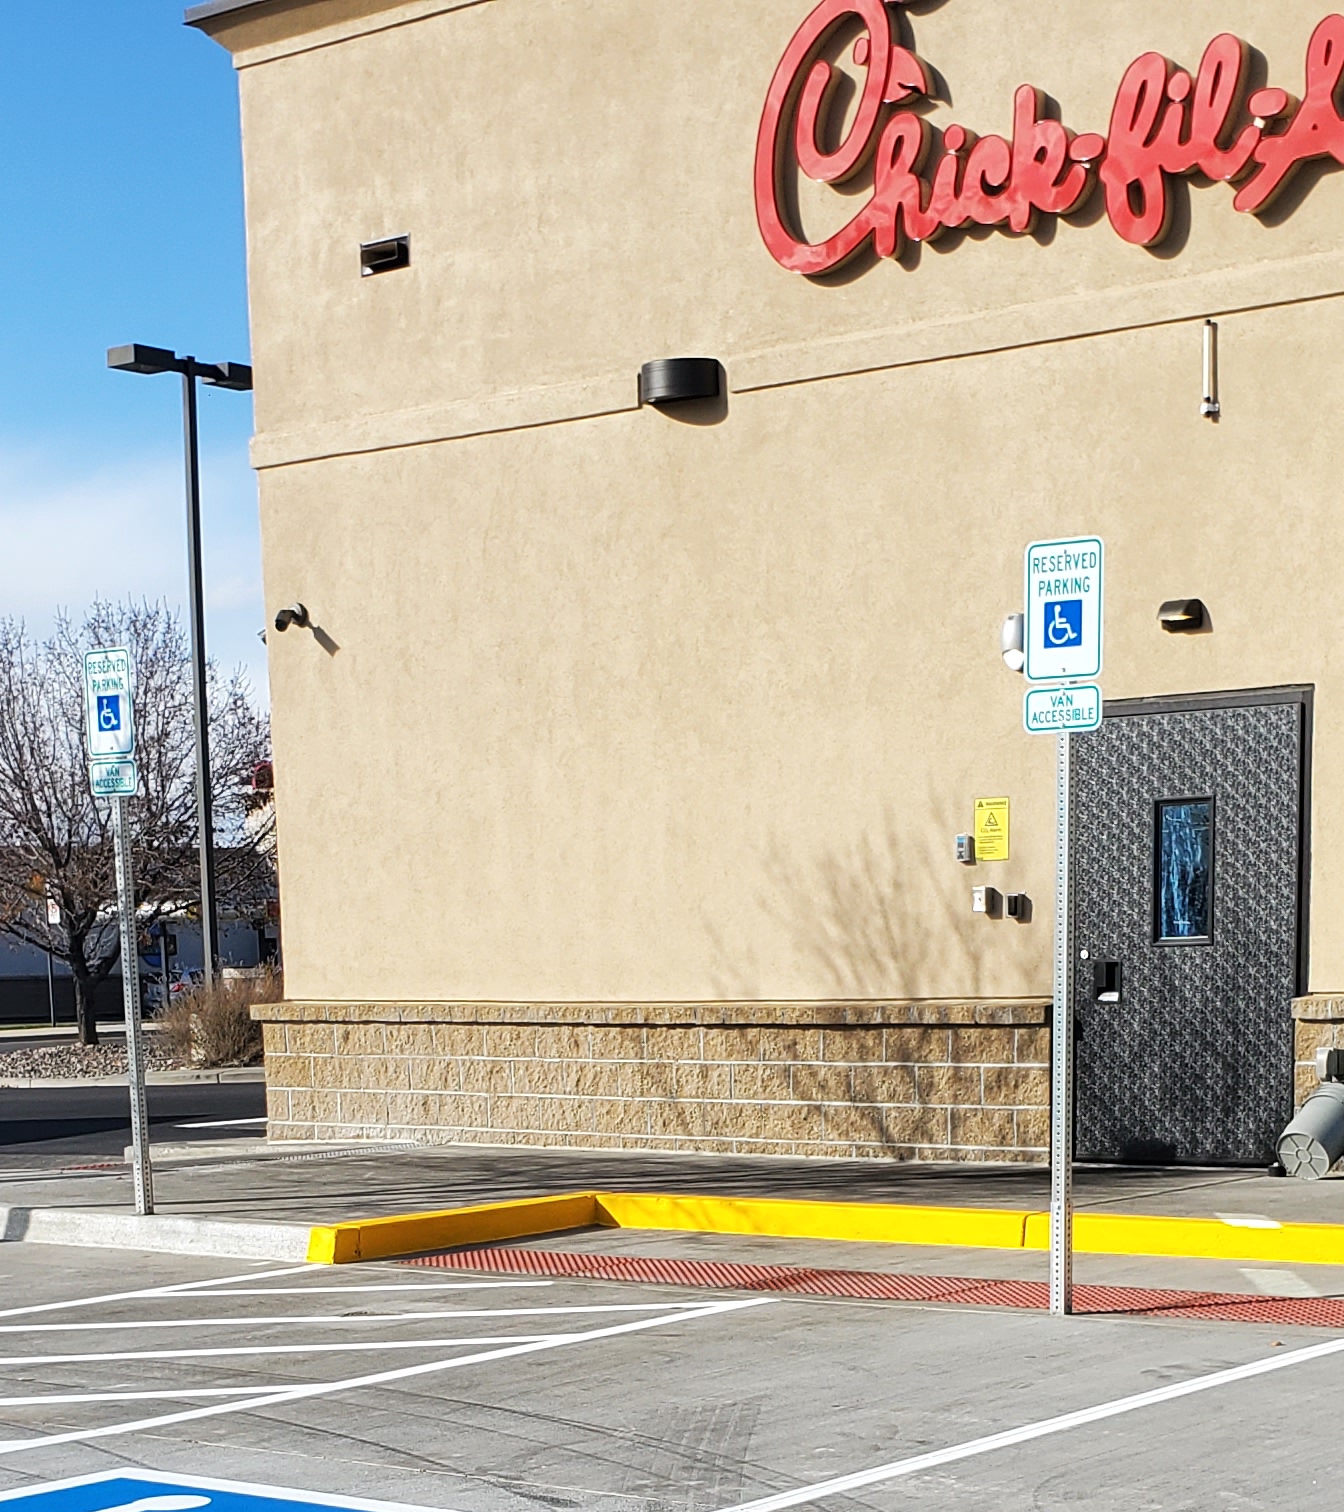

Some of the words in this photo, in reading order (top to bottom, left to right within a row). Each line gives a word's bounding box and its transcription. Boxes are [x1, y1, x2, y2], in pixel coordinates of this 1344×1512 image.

[1032, 552, 1097, 574] RESERVED
[1038, 576, 1090, 597] PARKING
[88, 659, 126, 675] RESERVED
[92, 678, 123, 692] PARKING
[1050, 694, 1073, 708] VAN
[1032, 707, 1094, 724] ACCESSIBLE
[105, 766, 120, 777] VAN
[95, 777, 132, 789] ACCESSIBLE
